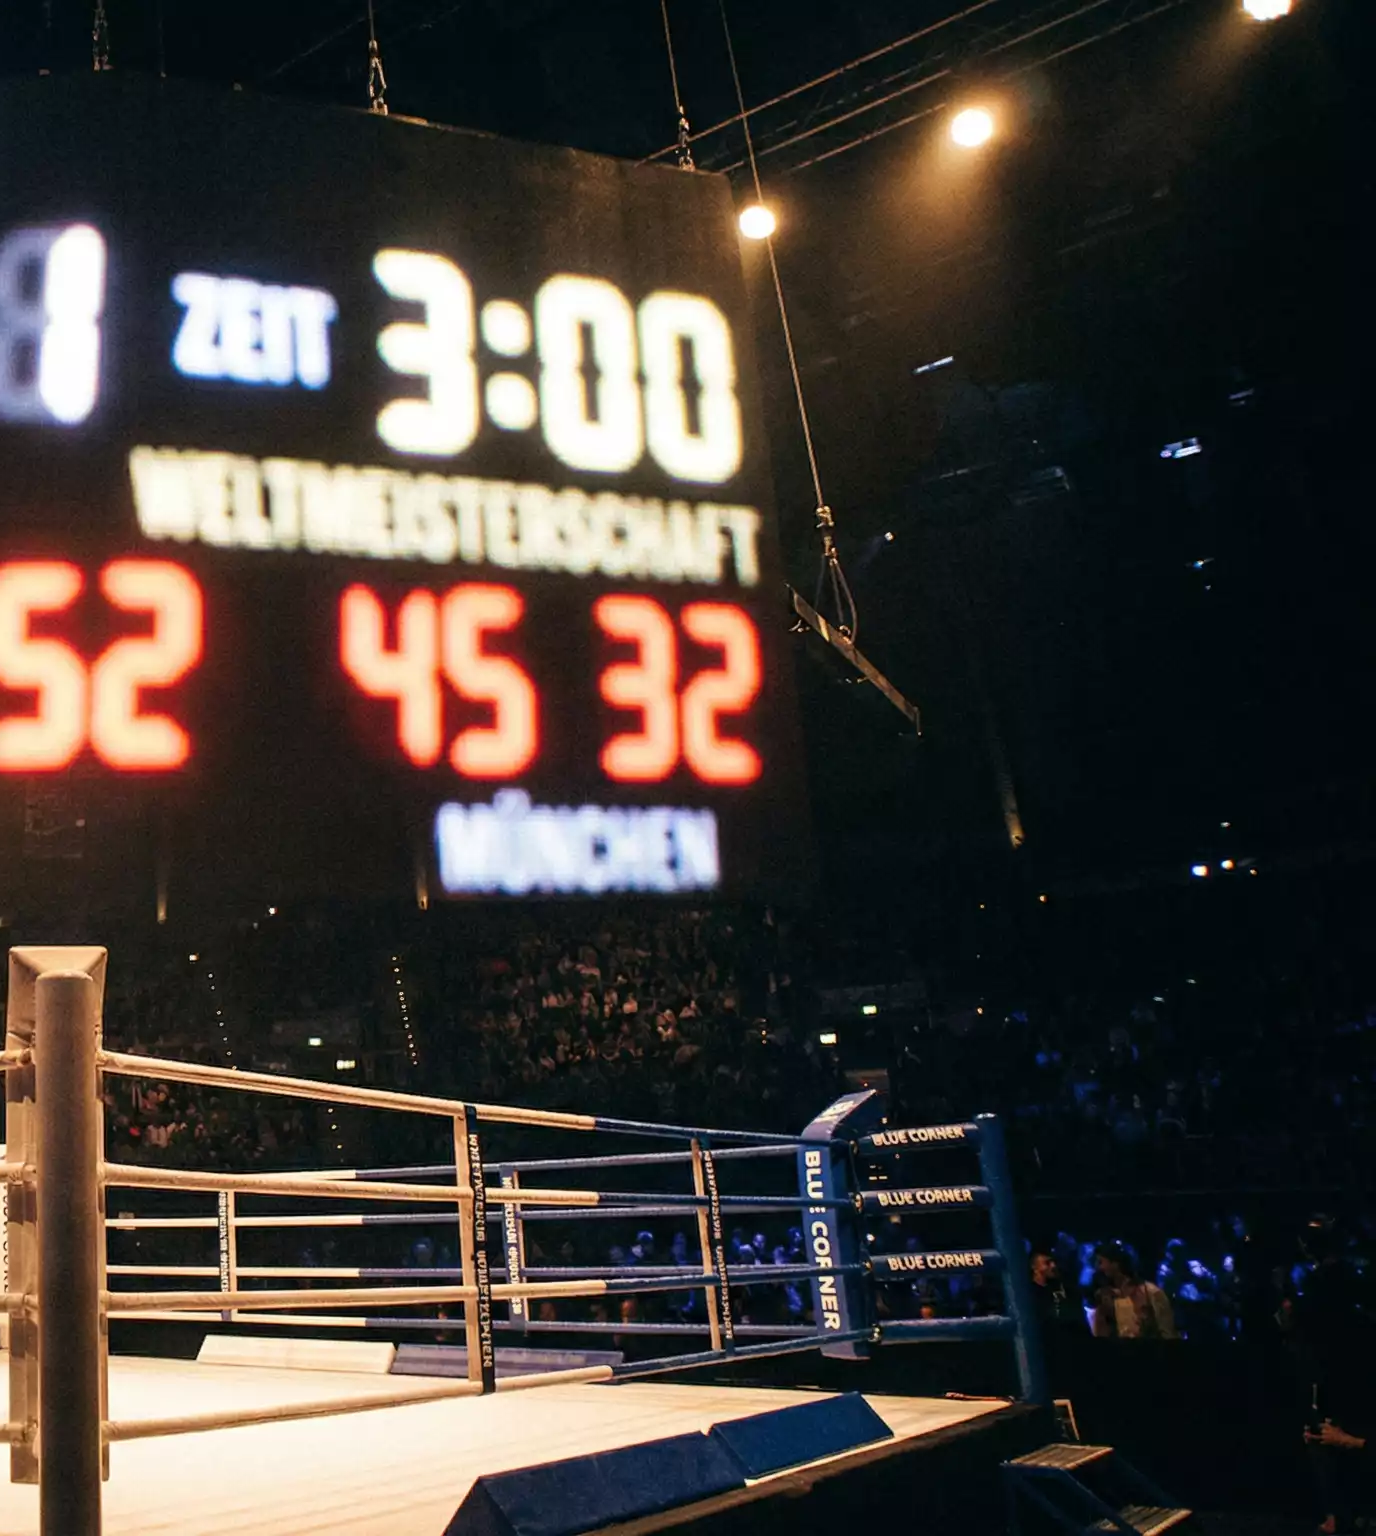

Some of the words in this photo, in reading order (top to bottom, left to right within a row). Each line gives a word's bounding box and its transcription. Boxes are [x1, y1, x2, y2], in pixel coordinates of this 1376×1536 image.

[171, 271, 339, 390] ZEIT
[372, 247, 744, 484] 3:00
[129, 444, 762, 588] WELTMEISTERSCHAFT
[339, 582, 540, 780] 45
[593, 593, 762, 785] 32
[433, 787, 722, 895] MÜNCHEN
[871, 1130, 909, 1146] BLUE
[910, 1125, 965, 1142] CORNER
[877, 1191, 914, 1207] BLUE
[916, 1188, 973, 1204] CORNER
[811, 1221, 841, 1330] CORNER
[887, 1256, 925, 1271] BLUE
[926, 1253, 984, 1268] CORNER
